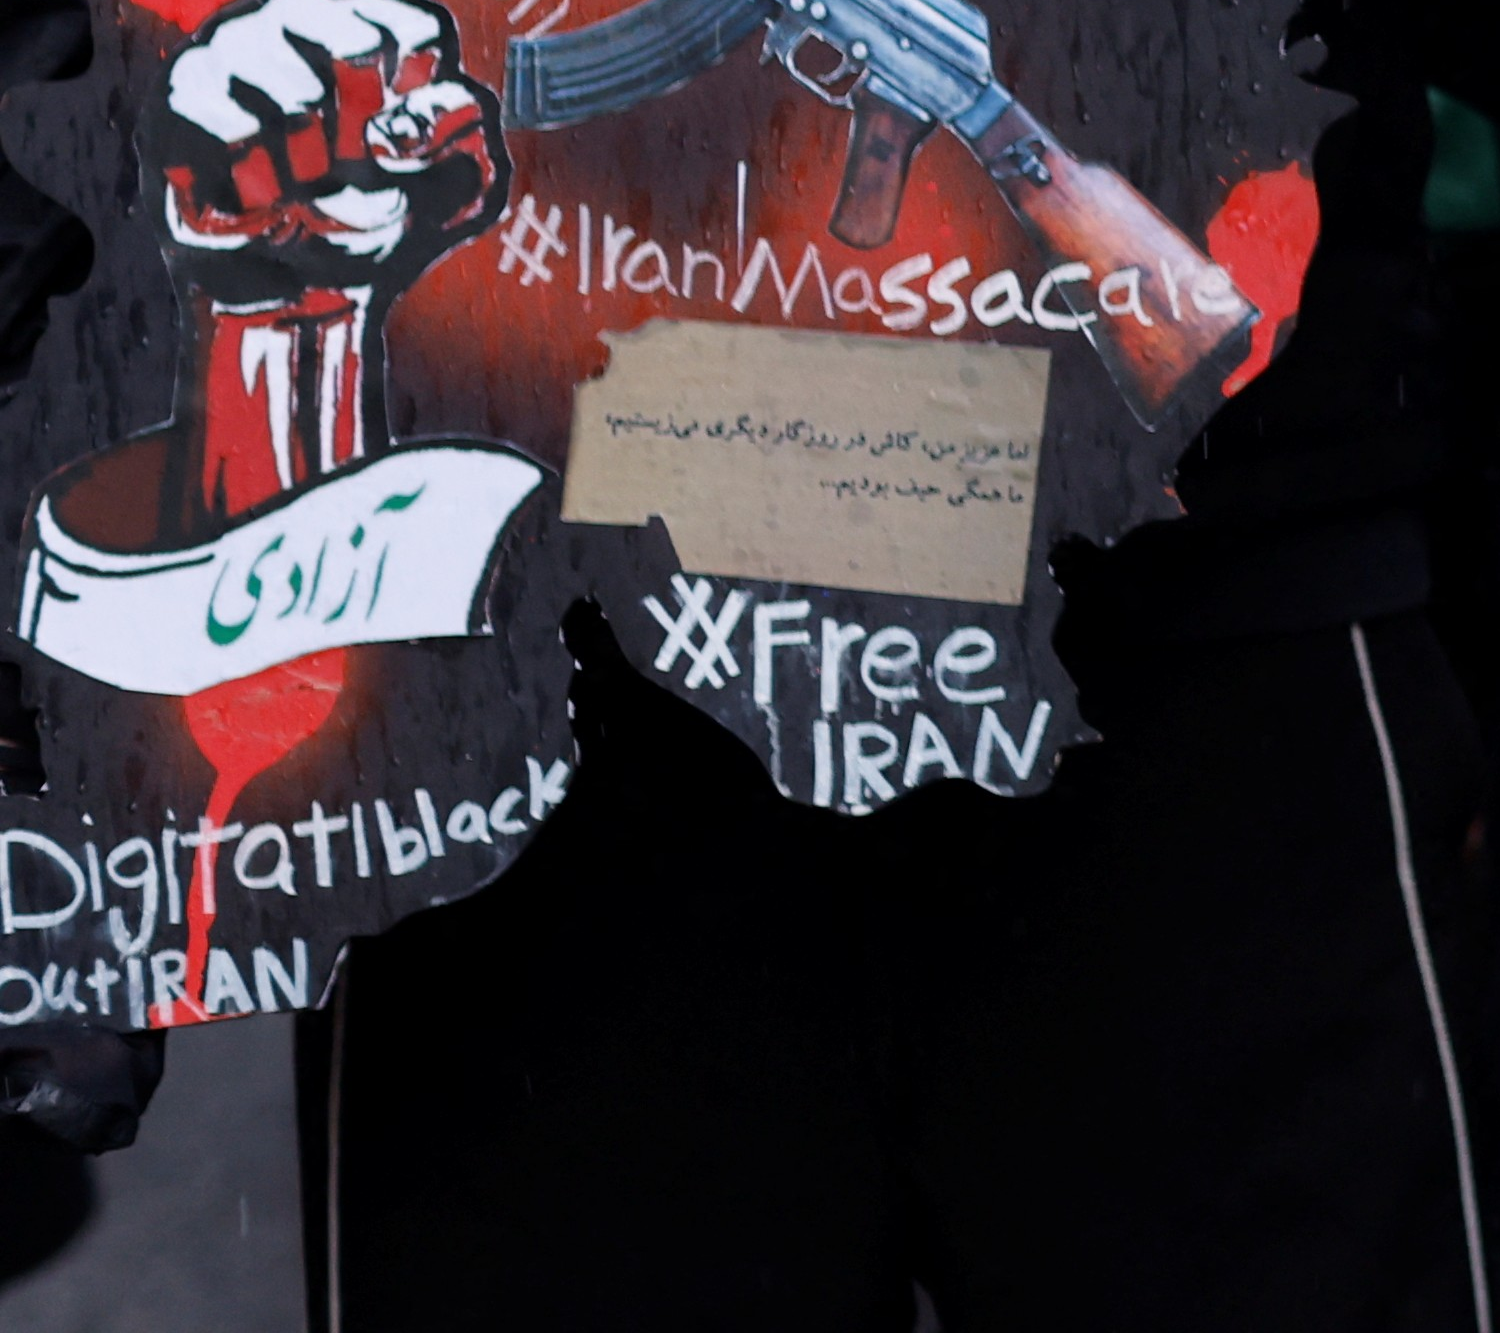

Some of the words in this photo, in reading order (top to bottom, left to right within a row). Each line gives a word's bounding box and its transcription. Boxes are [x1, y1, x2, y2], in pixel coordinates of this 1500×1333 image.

[204, 481, 427, 646] آزادی
[643, 572, 1008, 711] #Free
[813, 699, 1050, 808] IRAN
